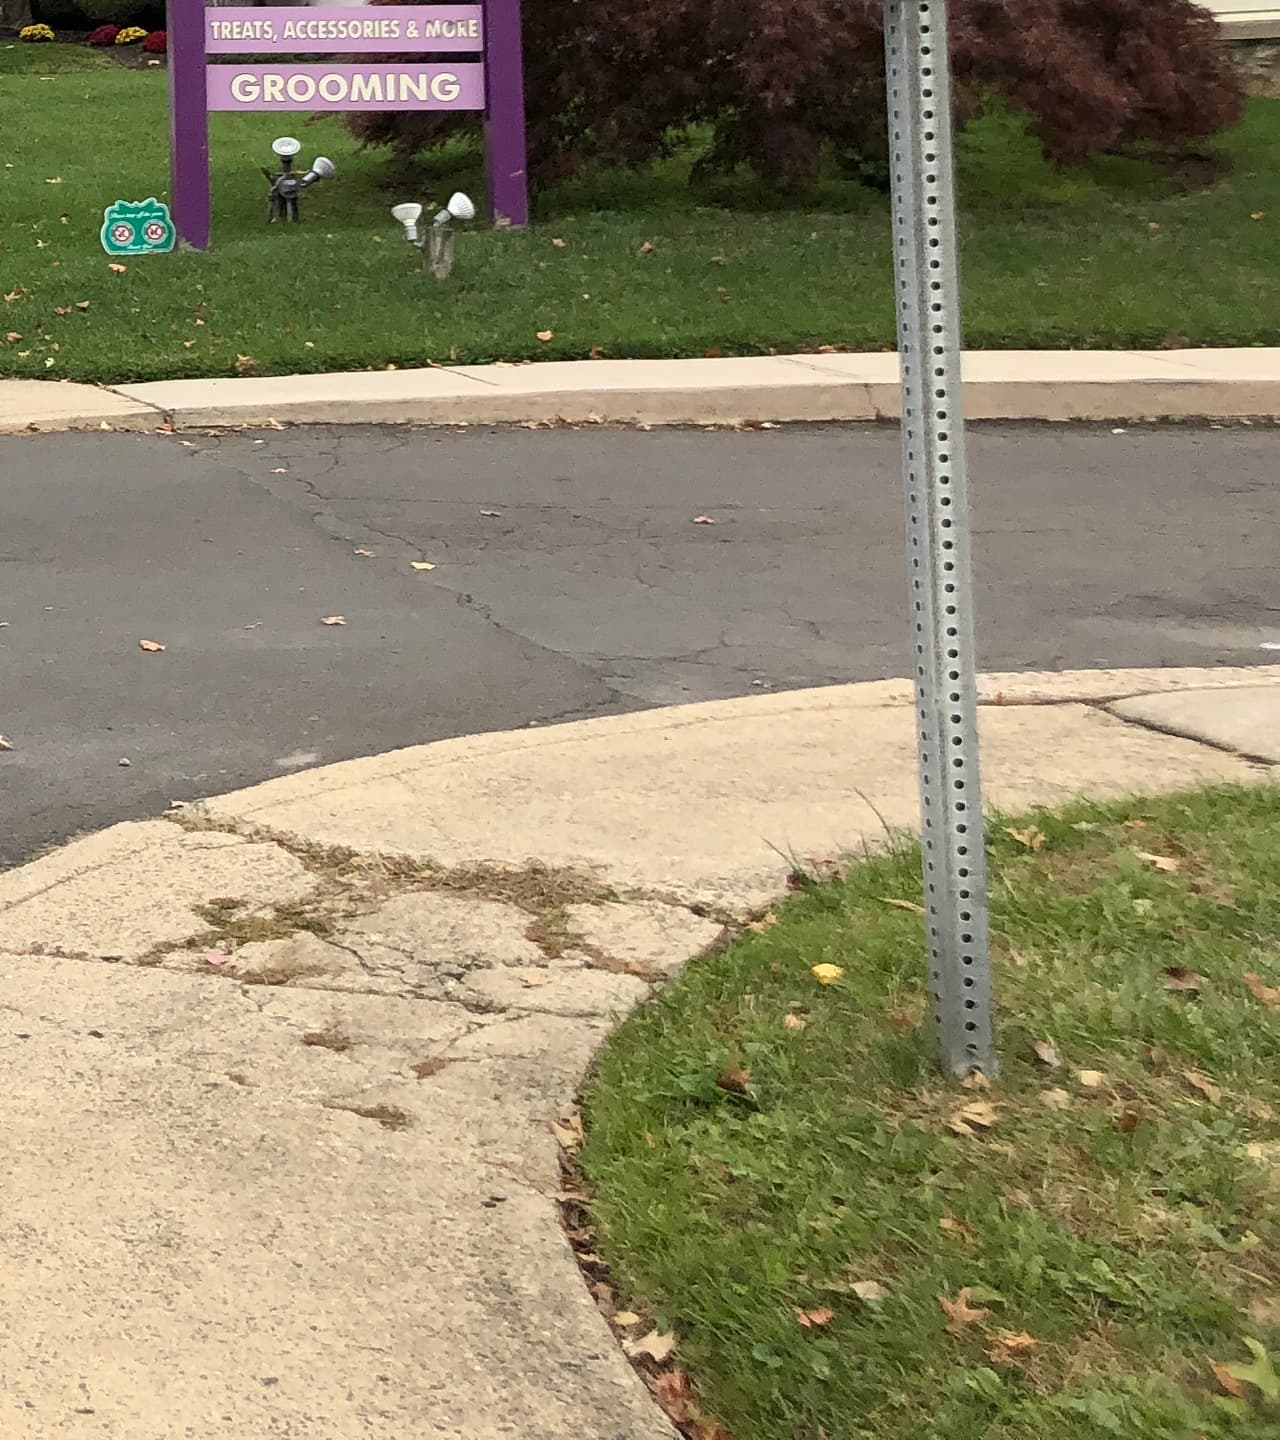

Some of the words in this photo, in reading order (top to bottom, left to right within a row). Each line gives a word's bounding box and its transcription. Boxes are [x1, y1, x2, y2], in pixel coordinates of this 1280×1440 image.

[210, 20, 278, 43] TREATS,
[283, 19, 400, 40] ACCESSORIES
[406, 20, 420, 38] &
[425, 18, 479, 38] MORE
[230, 73, 461, 104] GROOMING
